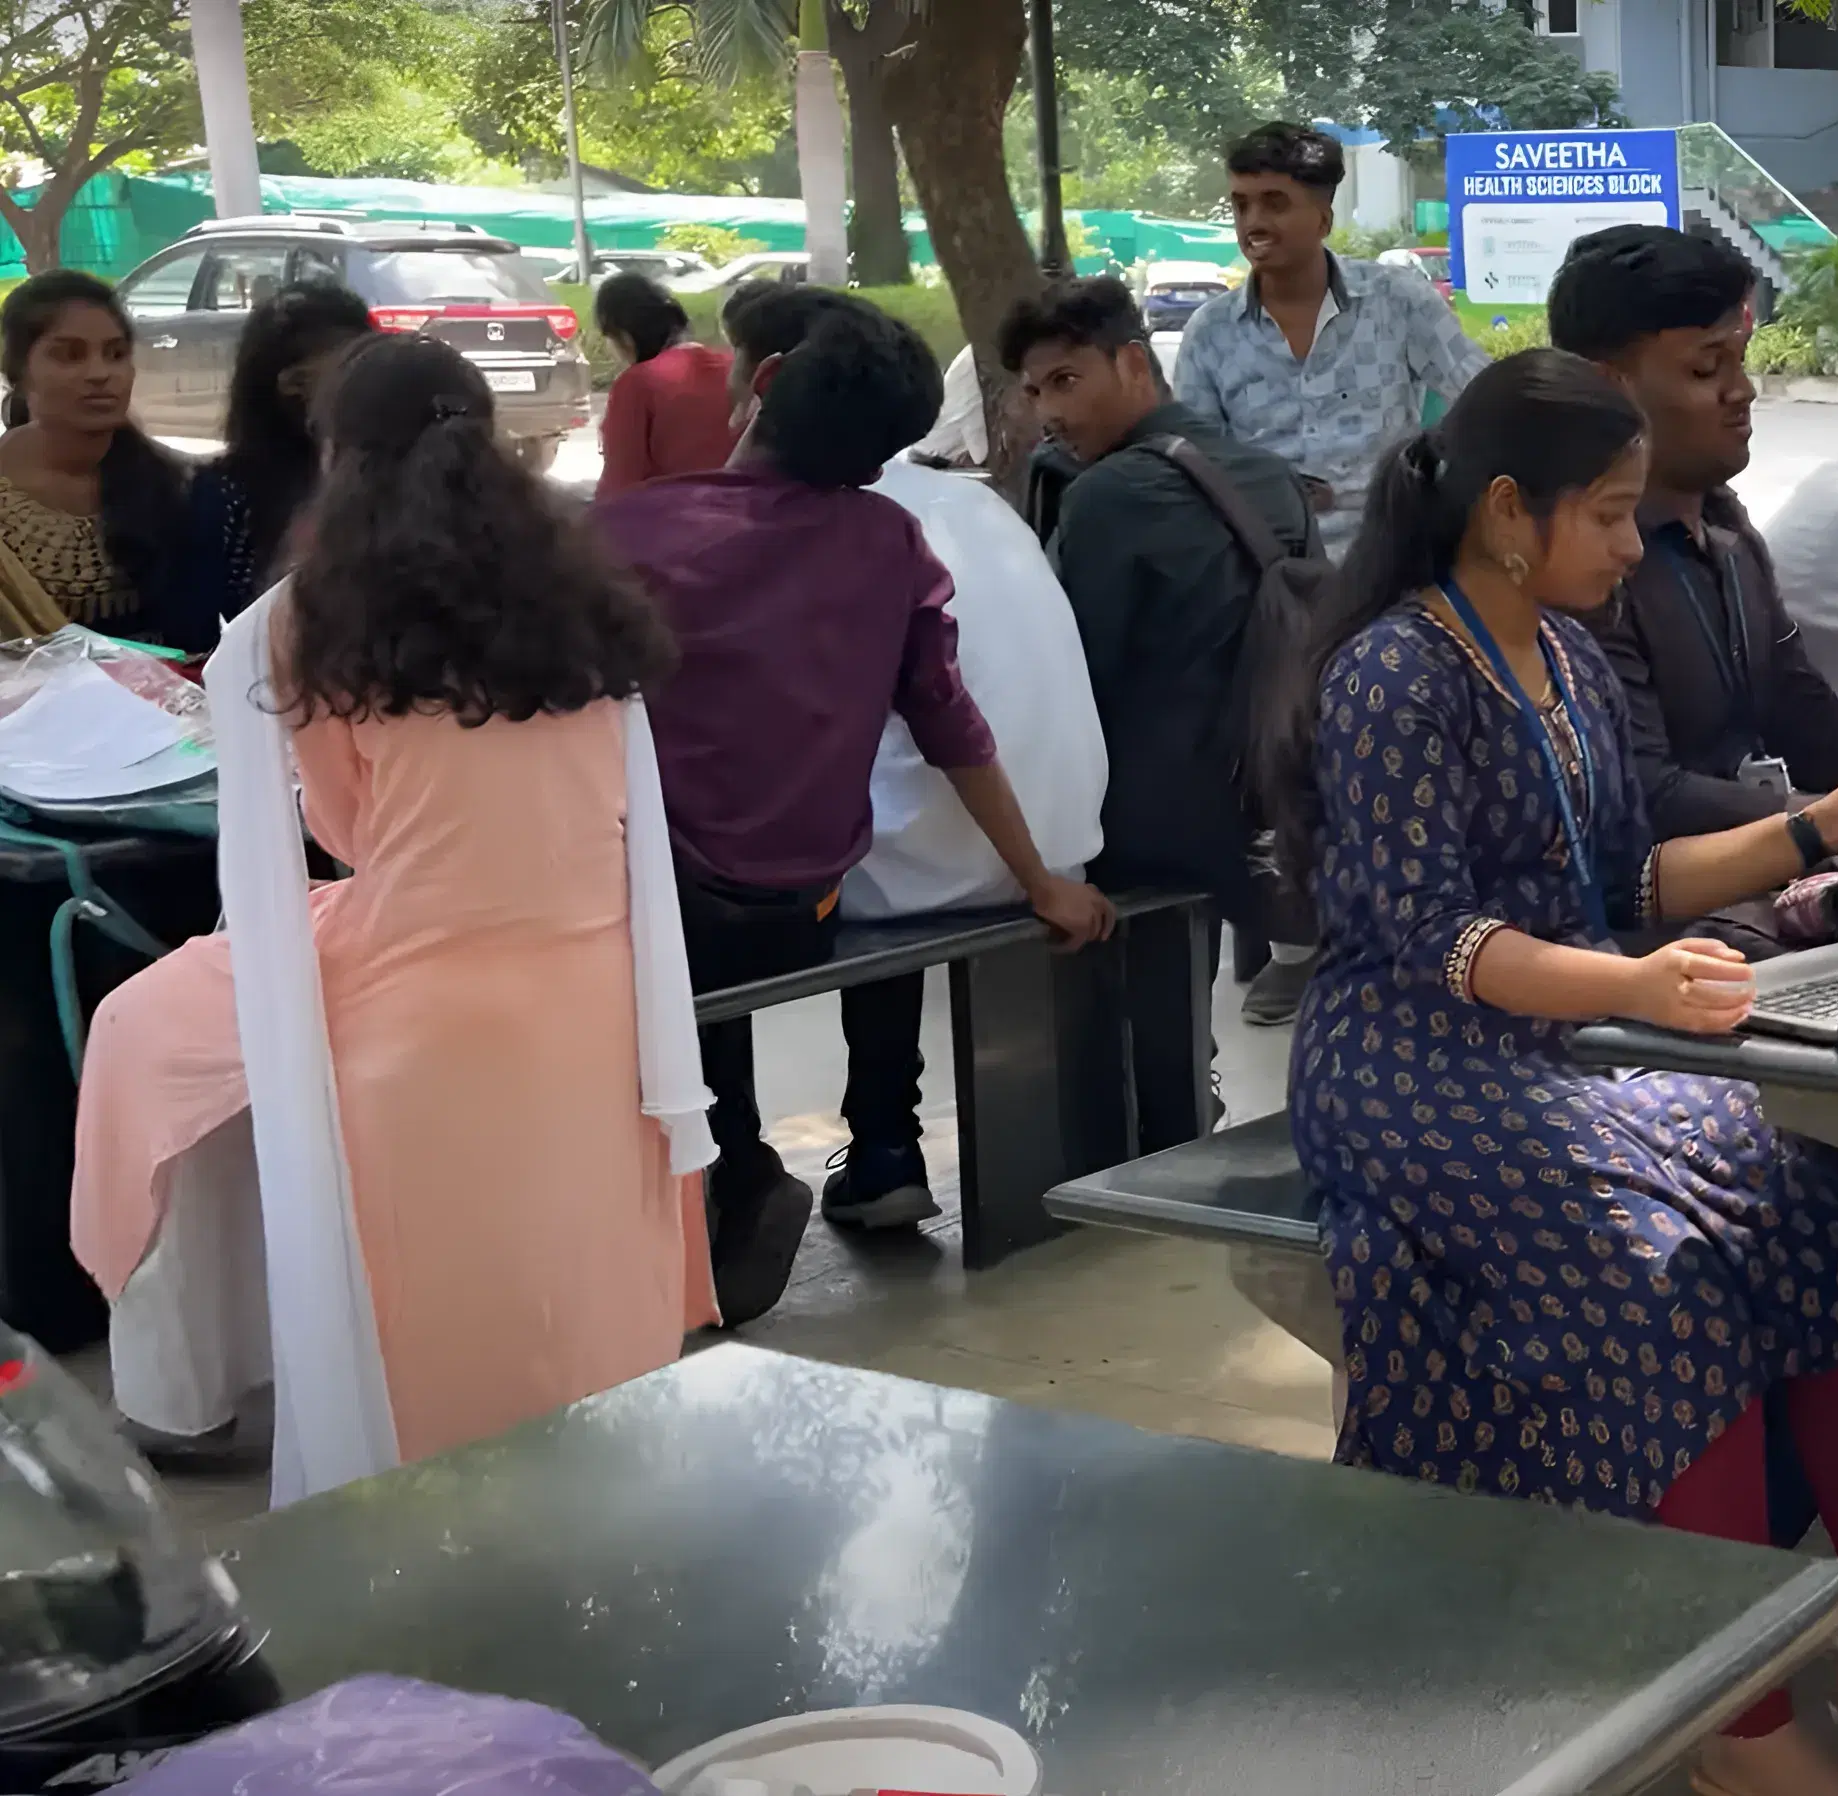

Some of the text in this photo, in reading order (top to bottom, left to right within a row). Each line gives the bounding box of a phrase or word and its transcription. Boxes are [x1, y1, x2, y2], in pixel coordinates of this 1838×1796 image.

[1495, 141, 1627, 169] SAVEETHA
[1464, 174, 1663, 196] HEALTH SCIENCES BLOCK
